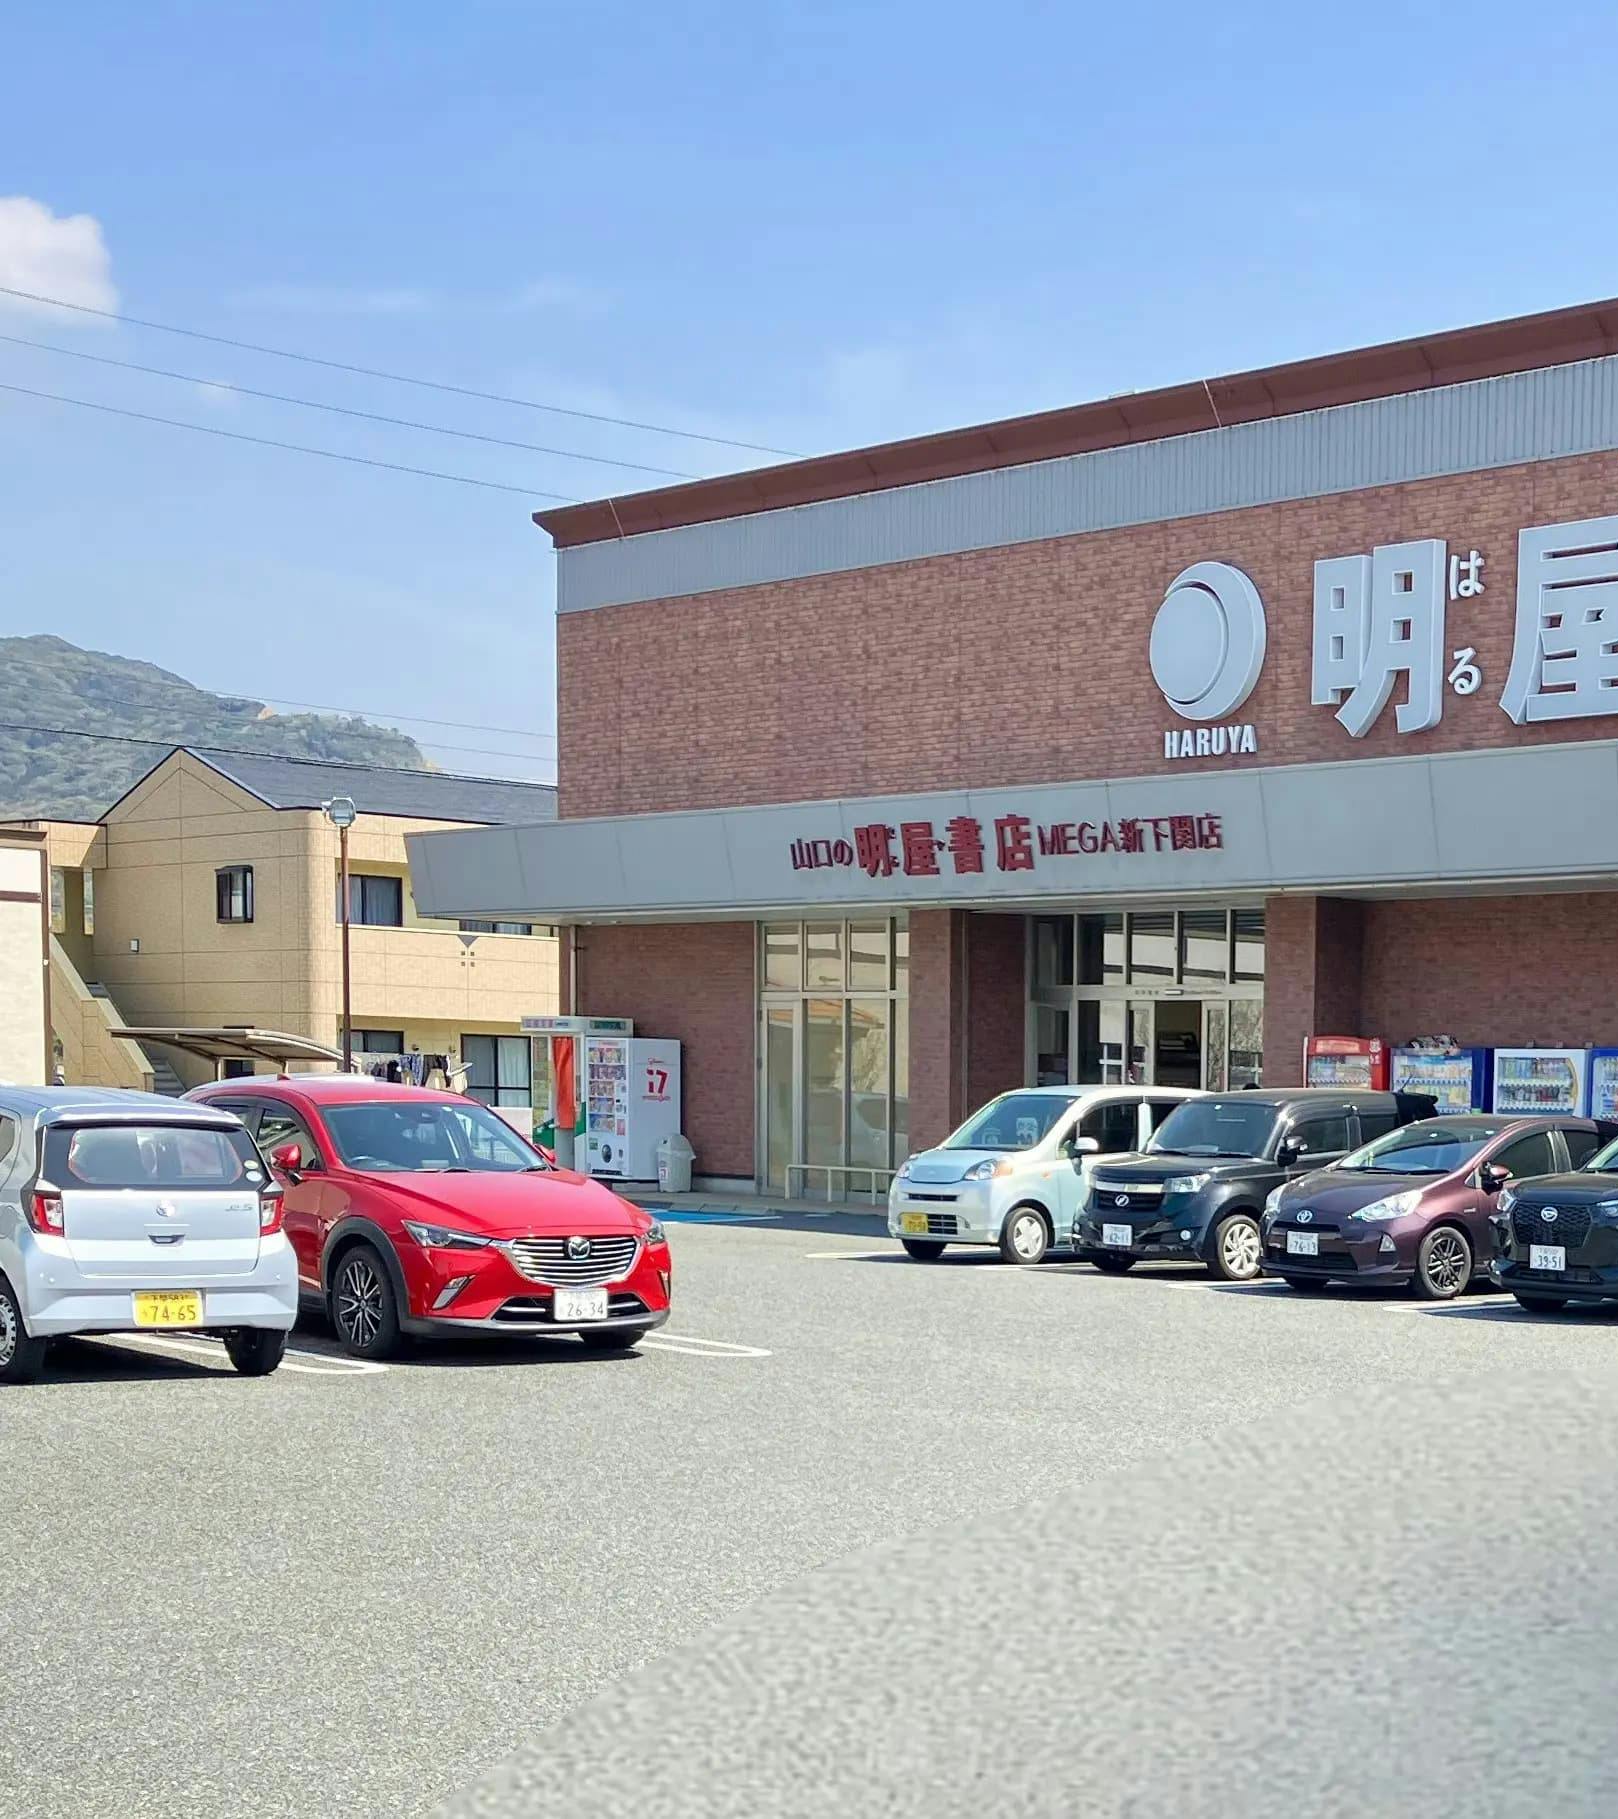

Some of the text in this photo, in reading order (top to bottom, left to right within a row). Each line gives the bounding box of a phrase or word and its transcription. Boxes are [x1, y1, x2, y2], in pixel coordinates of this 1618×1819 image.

[1164, 724, 1257, 759] HARUYA
[1537, 1255, 1562, 1269] 39-51
[150, 1305, 196, 1322] 74-65
[567, 1302, 604, 1317] 26-34
